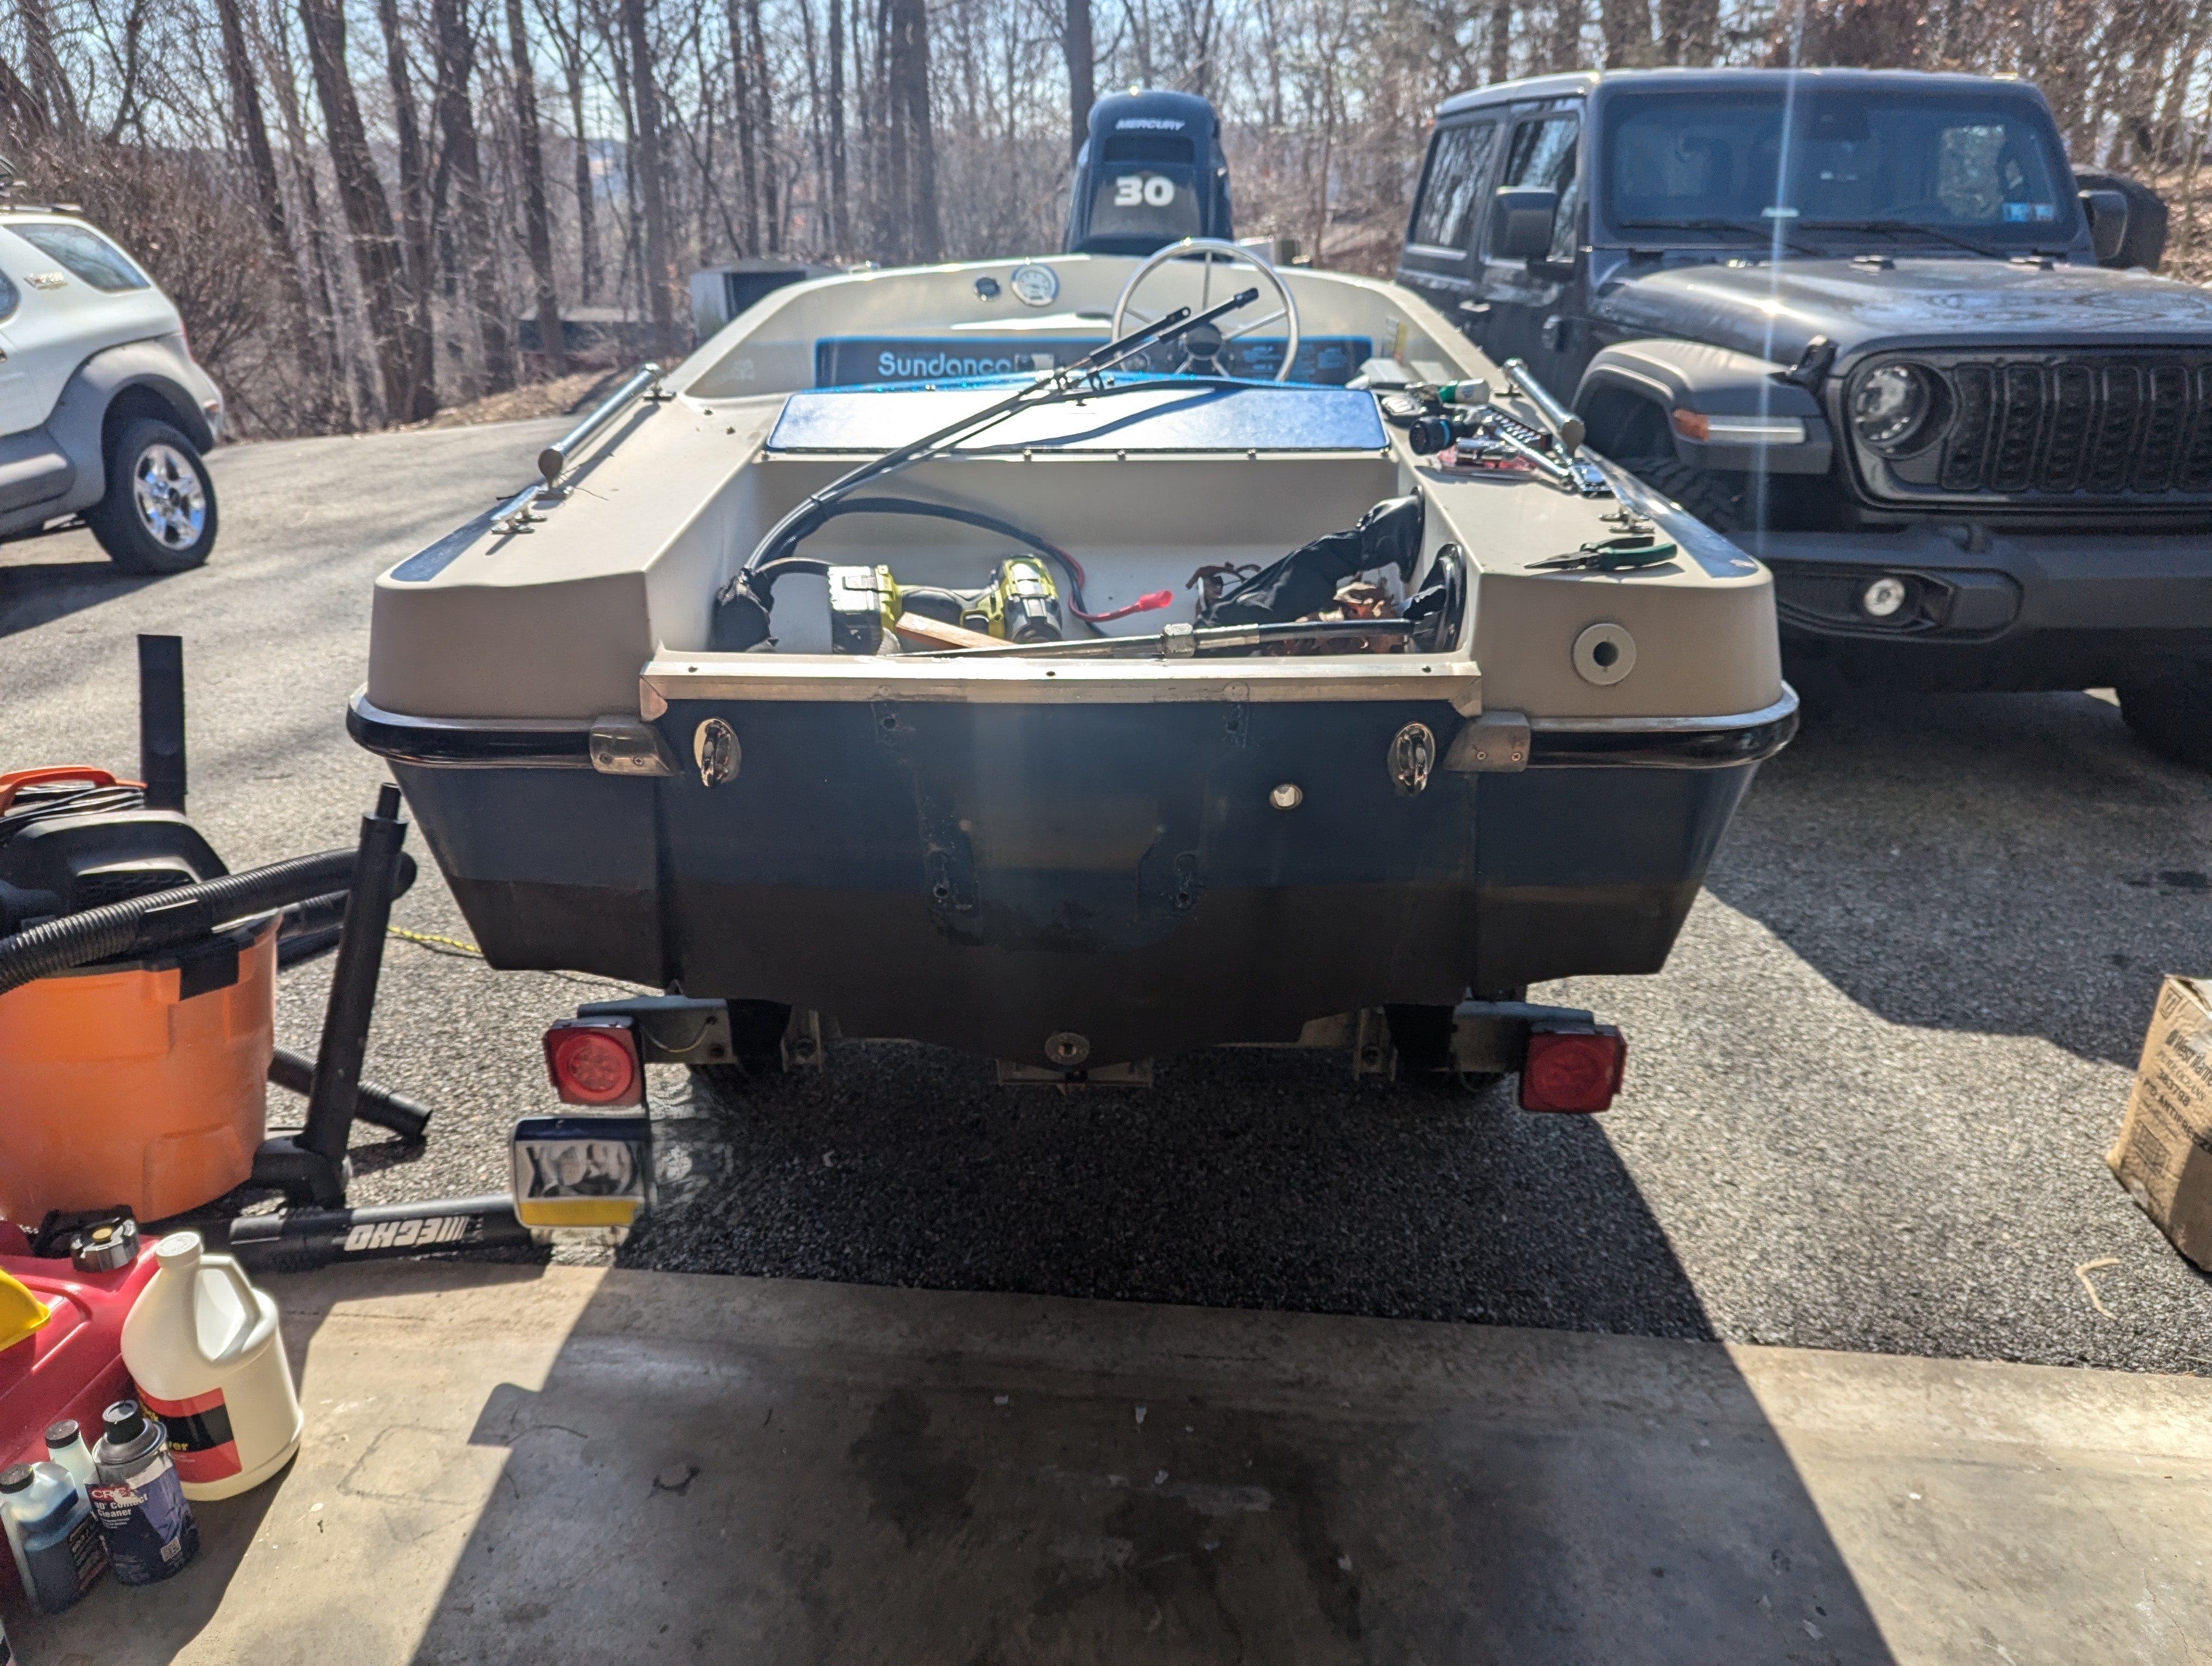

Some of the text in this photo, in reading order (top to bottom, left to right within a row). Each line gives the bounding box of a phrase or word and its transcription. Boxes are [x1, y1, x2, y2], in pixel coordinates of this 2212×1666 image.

[1115, 118, 1186, 131] MERCURY
[1114, 175, 1175, 207] 30
[877, 351, 1012, 376] Sundance
[2156, 1049, 2178, 1072] PURE
[2175, 1068, 2207, 1101] OCEANS
[343, 1218, 443, 1252] ECHO
[91, 1488, 127, 1498] CRC
[97, 1509, 131, 1517] Cleaner
